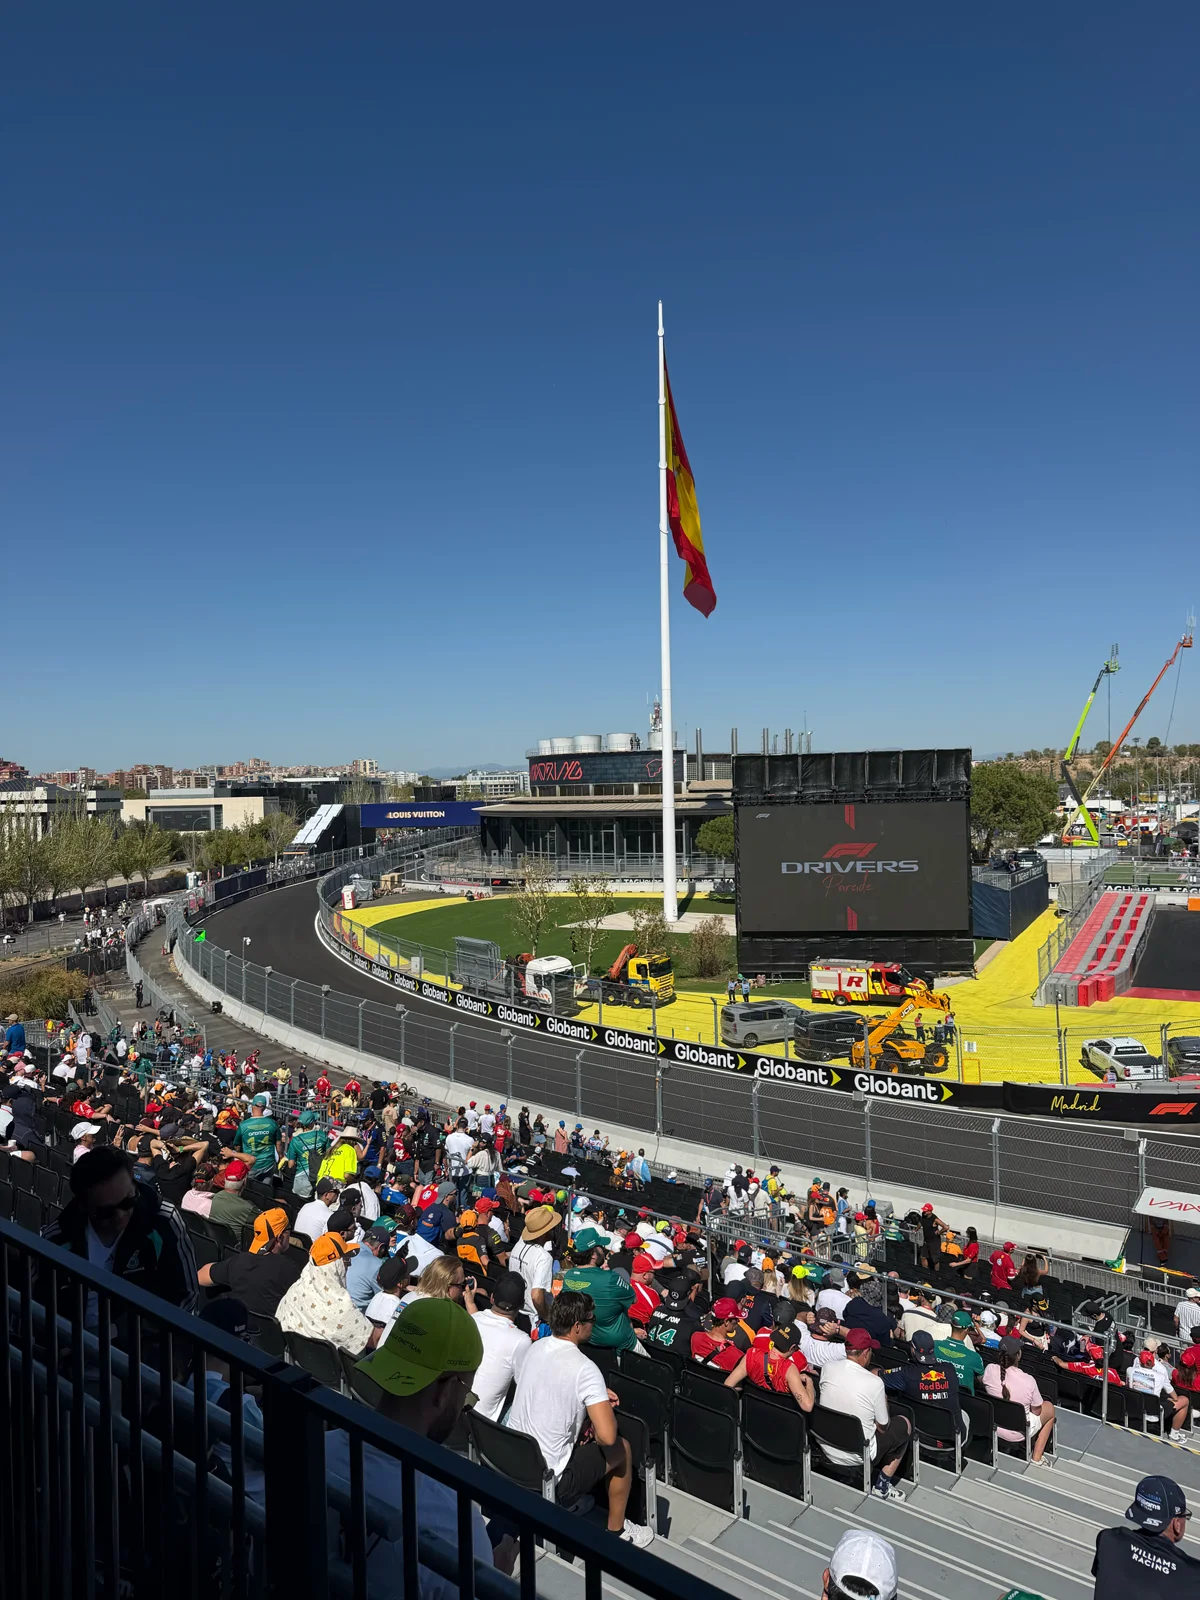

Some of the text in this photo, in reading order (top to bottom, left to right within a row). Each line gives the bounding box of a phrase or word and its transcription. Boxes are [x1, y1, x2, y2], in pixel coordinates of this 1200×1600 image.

[388, 810, 445, 819] LOUIS VUITTON
[781, 860, 919, 874] DRIVERS
[822, 869, 874, 898] Parade
[371, 963, 389, 981] Globant
[394, 973, 415, 991] Globant
[846, 976, 863, 988] R
[422, 983, 448, 1003] Globant
[456, 994, 487, 1014] Globant
[900, 1003, 915, 1018] JCB
[497, 1005, 534, 1027] Globant
[546, 1017, 590, 1041] Globant
[604, 1030, 656, 1055] Globant
[674, 1043, 735, 1069] Globant
[756, 1057, 829, 1086] Globant
[854, 1073, 938, 1101] Globant
[1050, 1092, 1101, 1114] Madrid
[919, 1381, 949, 1391] Red Bull
[921, 1392, 941, 1400] Mobil
[1130, 1543, 1177, 1571] WILLIAMS
[1131, 1553, 1170, 1575] RACING
